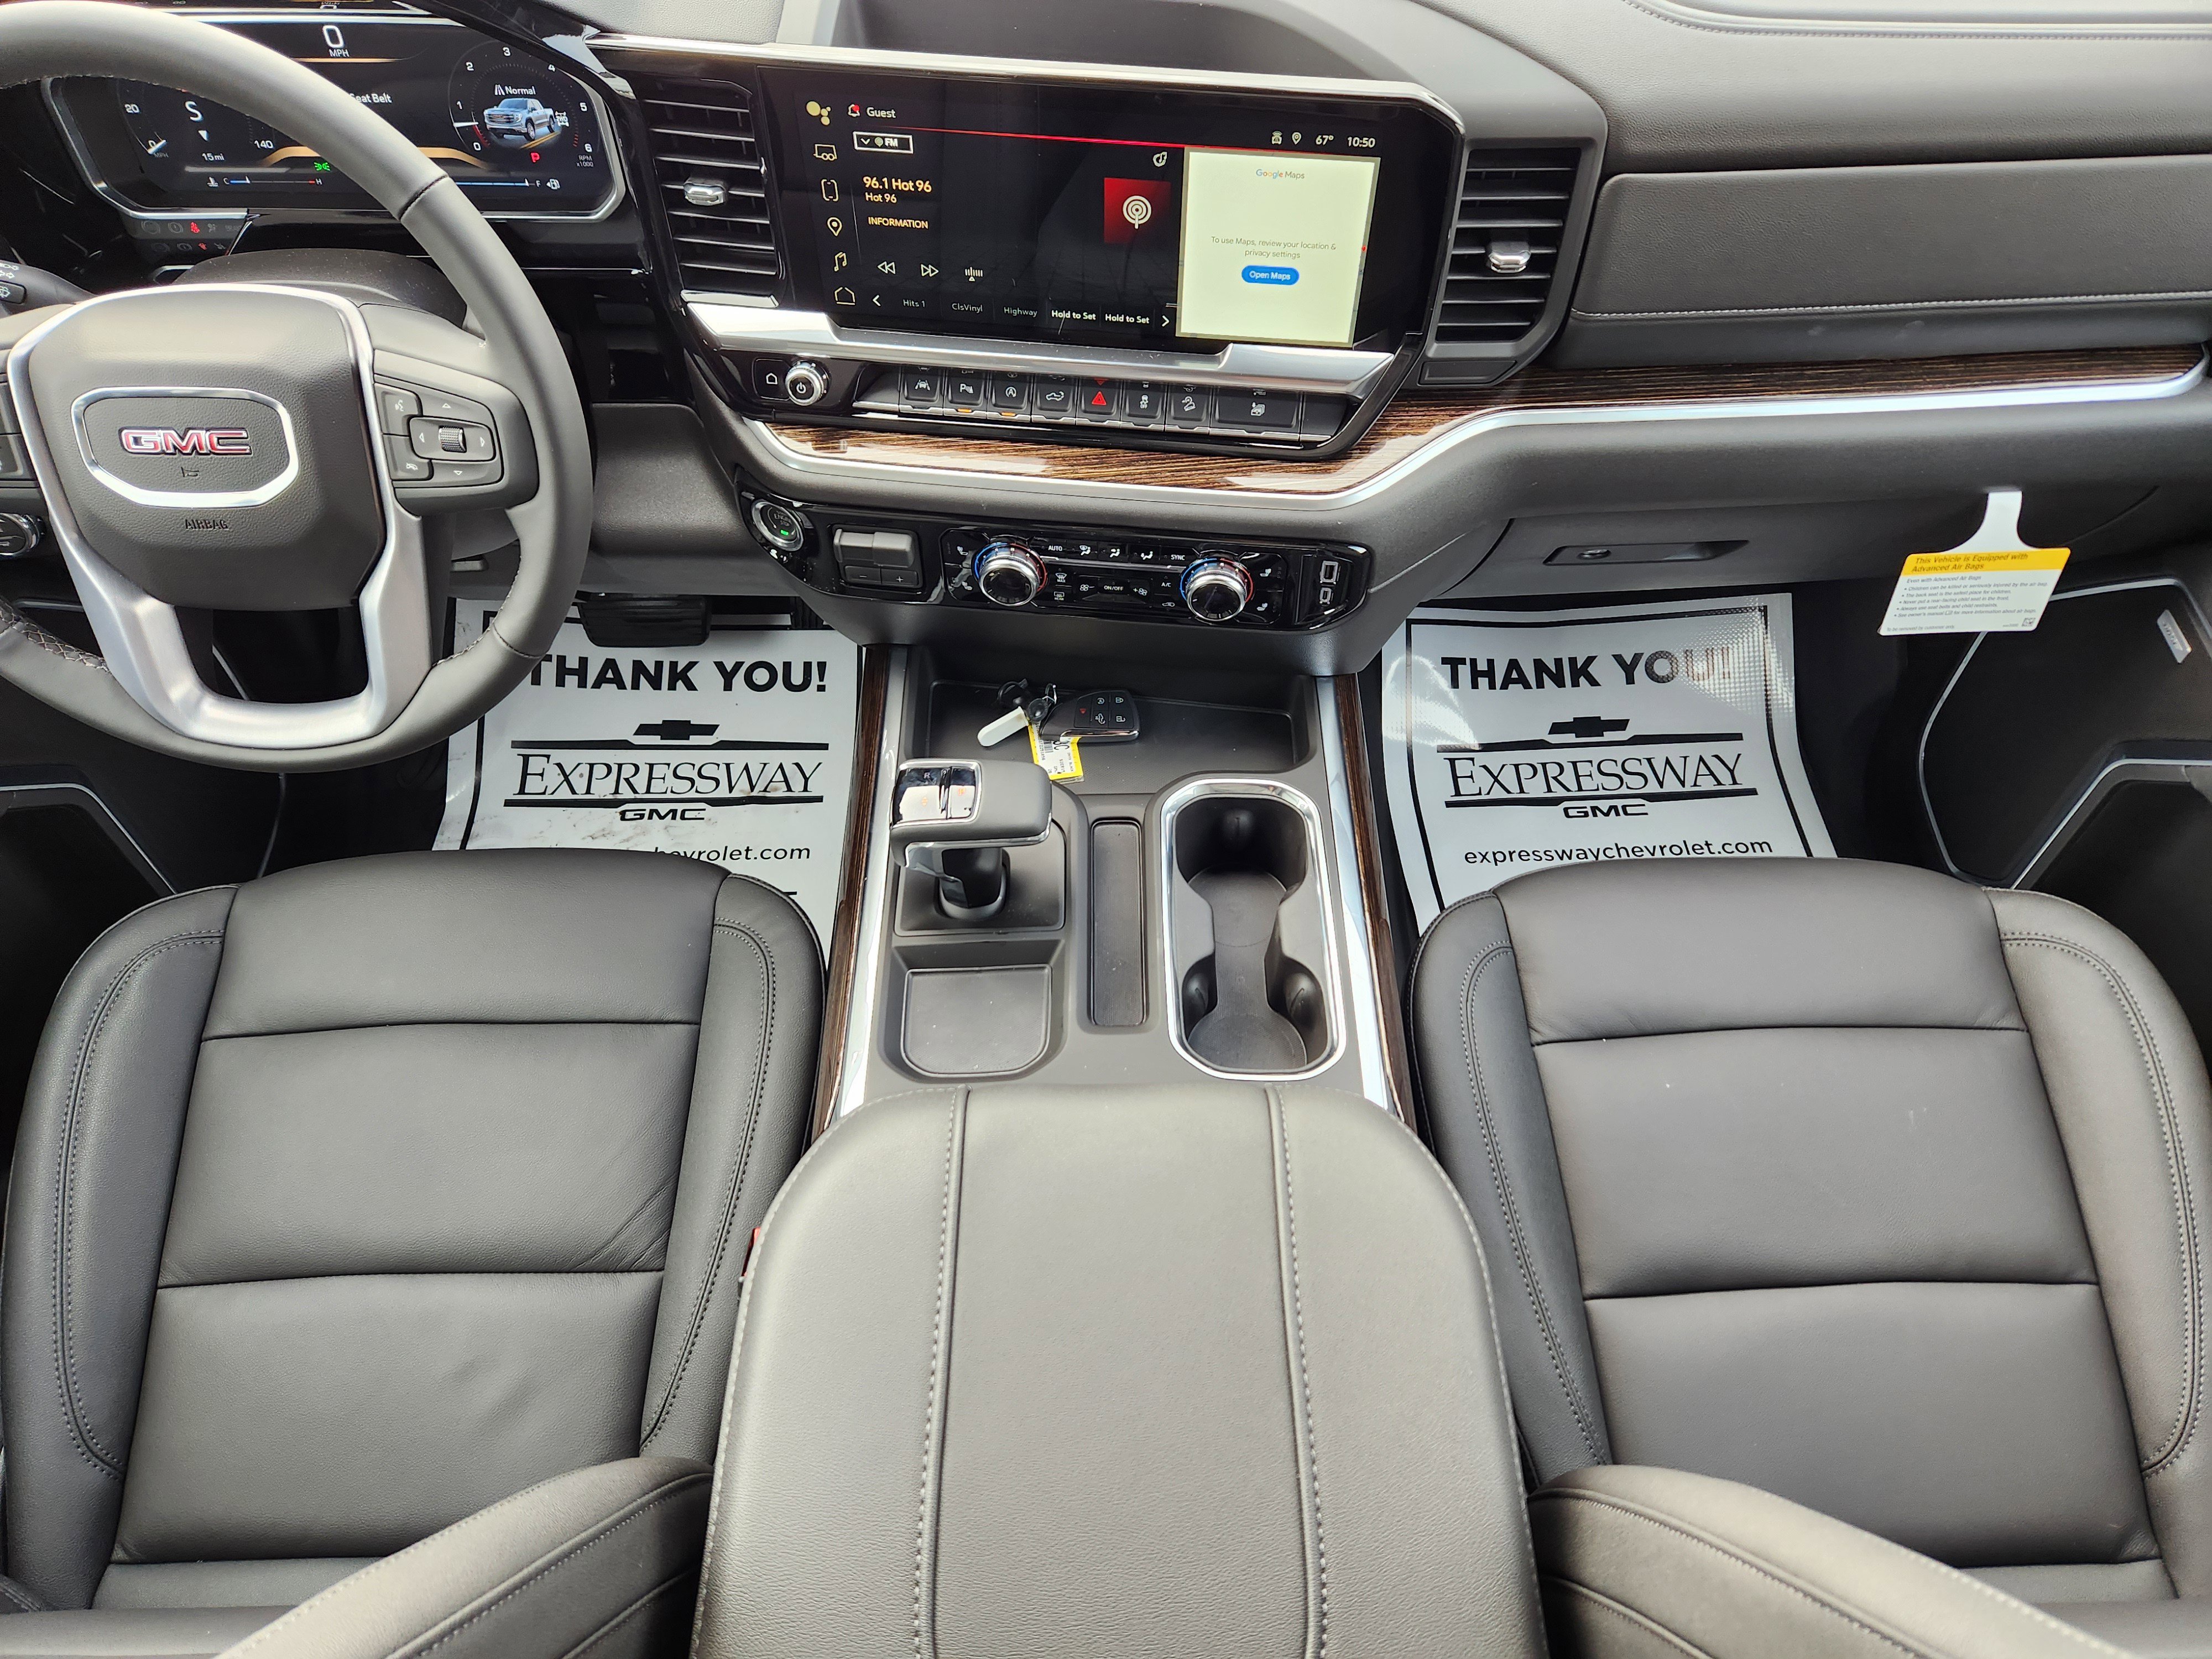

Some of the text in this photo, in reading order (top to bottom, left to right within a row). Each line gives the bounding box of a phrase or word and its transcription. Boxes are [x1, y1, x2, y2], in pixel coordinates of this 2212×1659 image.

[322, 25, 345, 48] 0
[328, 49, 349, 57] MPH
[503, 46, 511, 56] 3
[466, 62, 474, 71] 2
[548, 64, 555, 72] 4
[505, 86, 536, 96] Normal
[371, 92, 392, 103] Belt
[124, 103, 139, 113] 20
[456, 101, 463, 109] 1
[580, 102, 587, 111] 5
[185, 101, 204, 122] S
[867, 107, 896, 118] Guest
[254, 140, 274, 149] 140
[473, 142, 482, 152] 0
[584, 143, 593, 152] 6
[885, 138, 898, 147] FM
[1348, 137, 1375, 148] 10:50
[530, 152, 540, 163] P
[1256, 169, 1305, 179] Google Maps
[863, 176, 932, 192] 96.1 Hot 96
[865, 192, 897, 203] Hot 96
[868, 216, 928, 229] INFORMATION
[1235, 238, 1256, 246] Maps,
[1301, 242, 1328, 250] location
[1245, 249, 1300, 260] privacy settings
[1249, 270, 1291, 281] Open Maps
[903, 299, 920, 308] Hits
[952, 302, 983, 312] ClsVinyl
[1004, 306, 1037, 317] Highway
[1051, 310, 1071, 319] Hold
[1082, 312, 1096, 321] Set
[1105, 314, 1150, 325] Hold to Set
[119, 427, 252, 456] GMC
[185, 519, 228, 530] AIRBAG
[1973, 554, 2009, 562] Equipped
[1912, 564, 1950, 573] Advanced
[1441, 646, 1731, 690] THANK YOU!
[713, 660, 827, 692] YOU!
[619, 808, 706, 821] GMC
[1563, 804, 1648, 819] GMC
[1464, 839, 1773, 867] expresswaychevrolet.com
